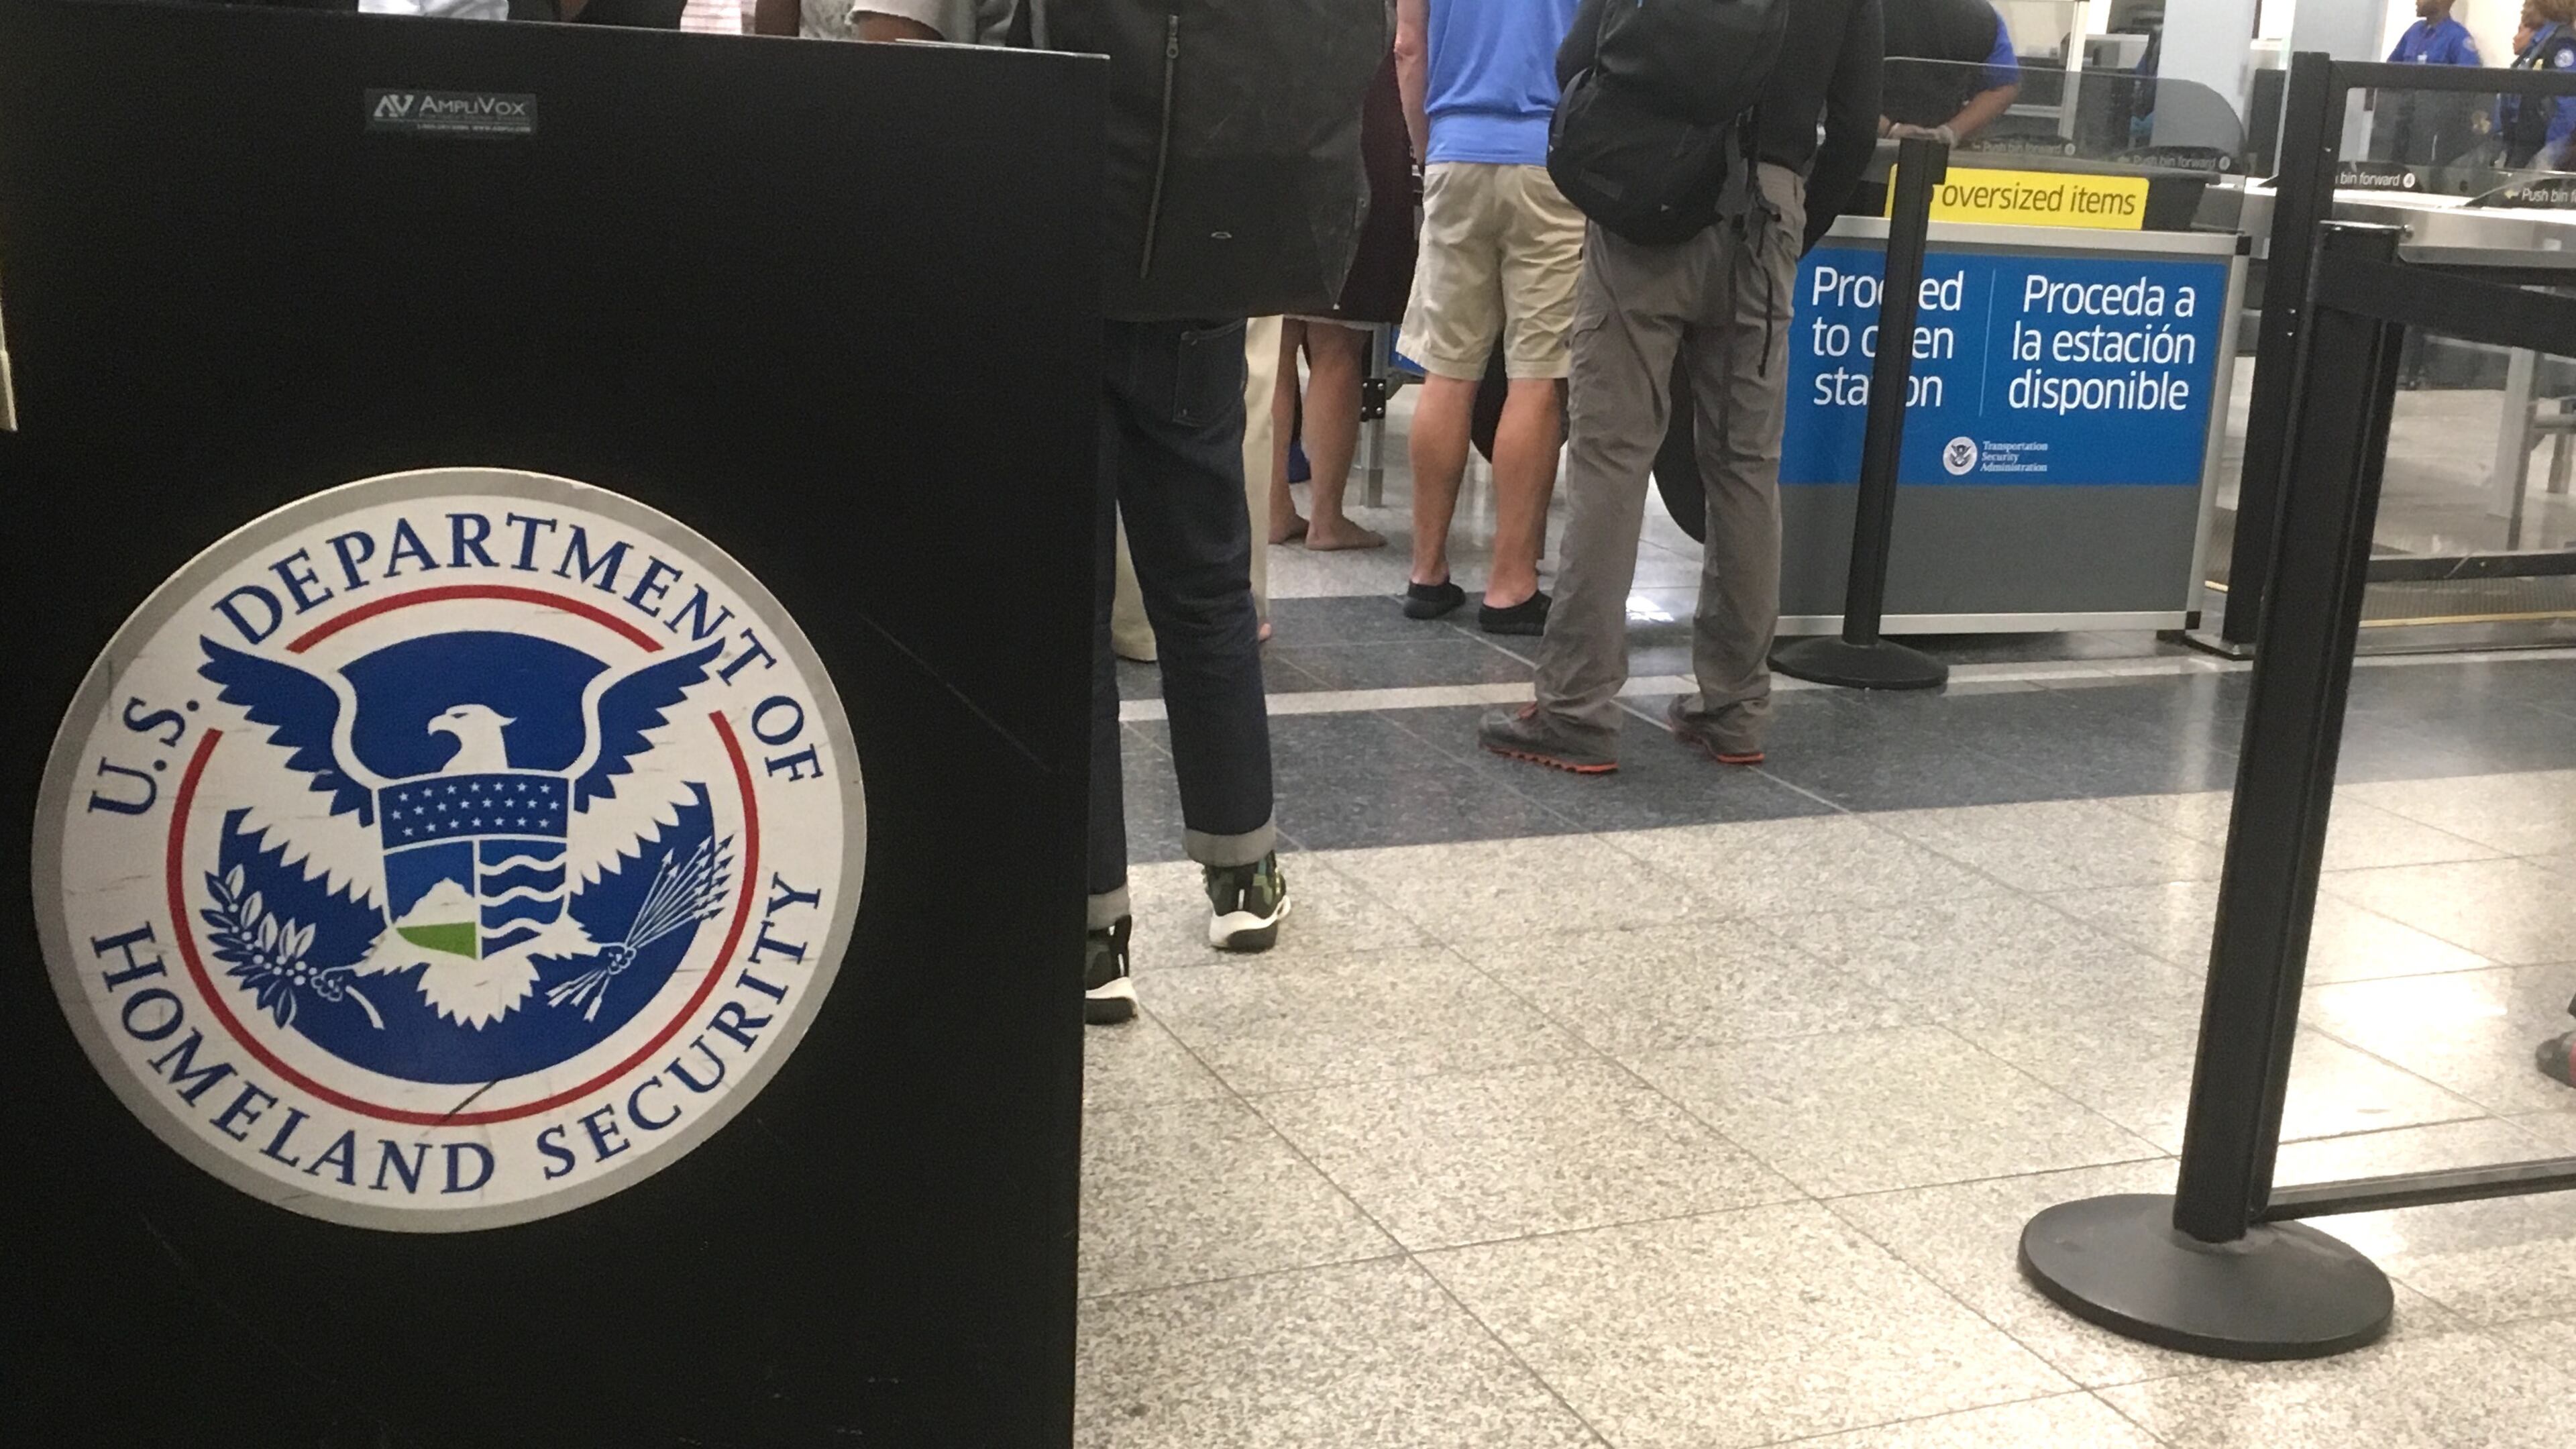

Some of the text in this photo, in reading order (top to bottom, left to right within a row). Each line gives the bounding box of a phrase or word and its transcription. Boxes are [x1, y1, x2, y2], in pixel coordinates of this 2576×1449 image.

[1941, 182, 2137, 215] oversized items
[2340, 171, 2357, 184] bin
[2359, 172, 2401, 186] forward
[2522, 188, 2548, 201] Push
[2551, 189, 2569, 203] bin
[1812, 266, 1964, 311] Proed
[2023, 274, 2196, 317] Proceda a
[1812, 316, 1954, 359] to oen
[2012, 320, 2196, 364] la estación
[1813, 366, 1943, 407] staon
[2008, 368, 2189, 416] disponible
[1980, 462, 2048, 472] Administration
[1981, 451, 2020, 464] Security
[1982, 441, 2049, 453] Transportation
[88, 511, 824, 817] U.S. DEPARTMENT OF
[90, 872, 822, 1195] HOMELAND SECURITY
